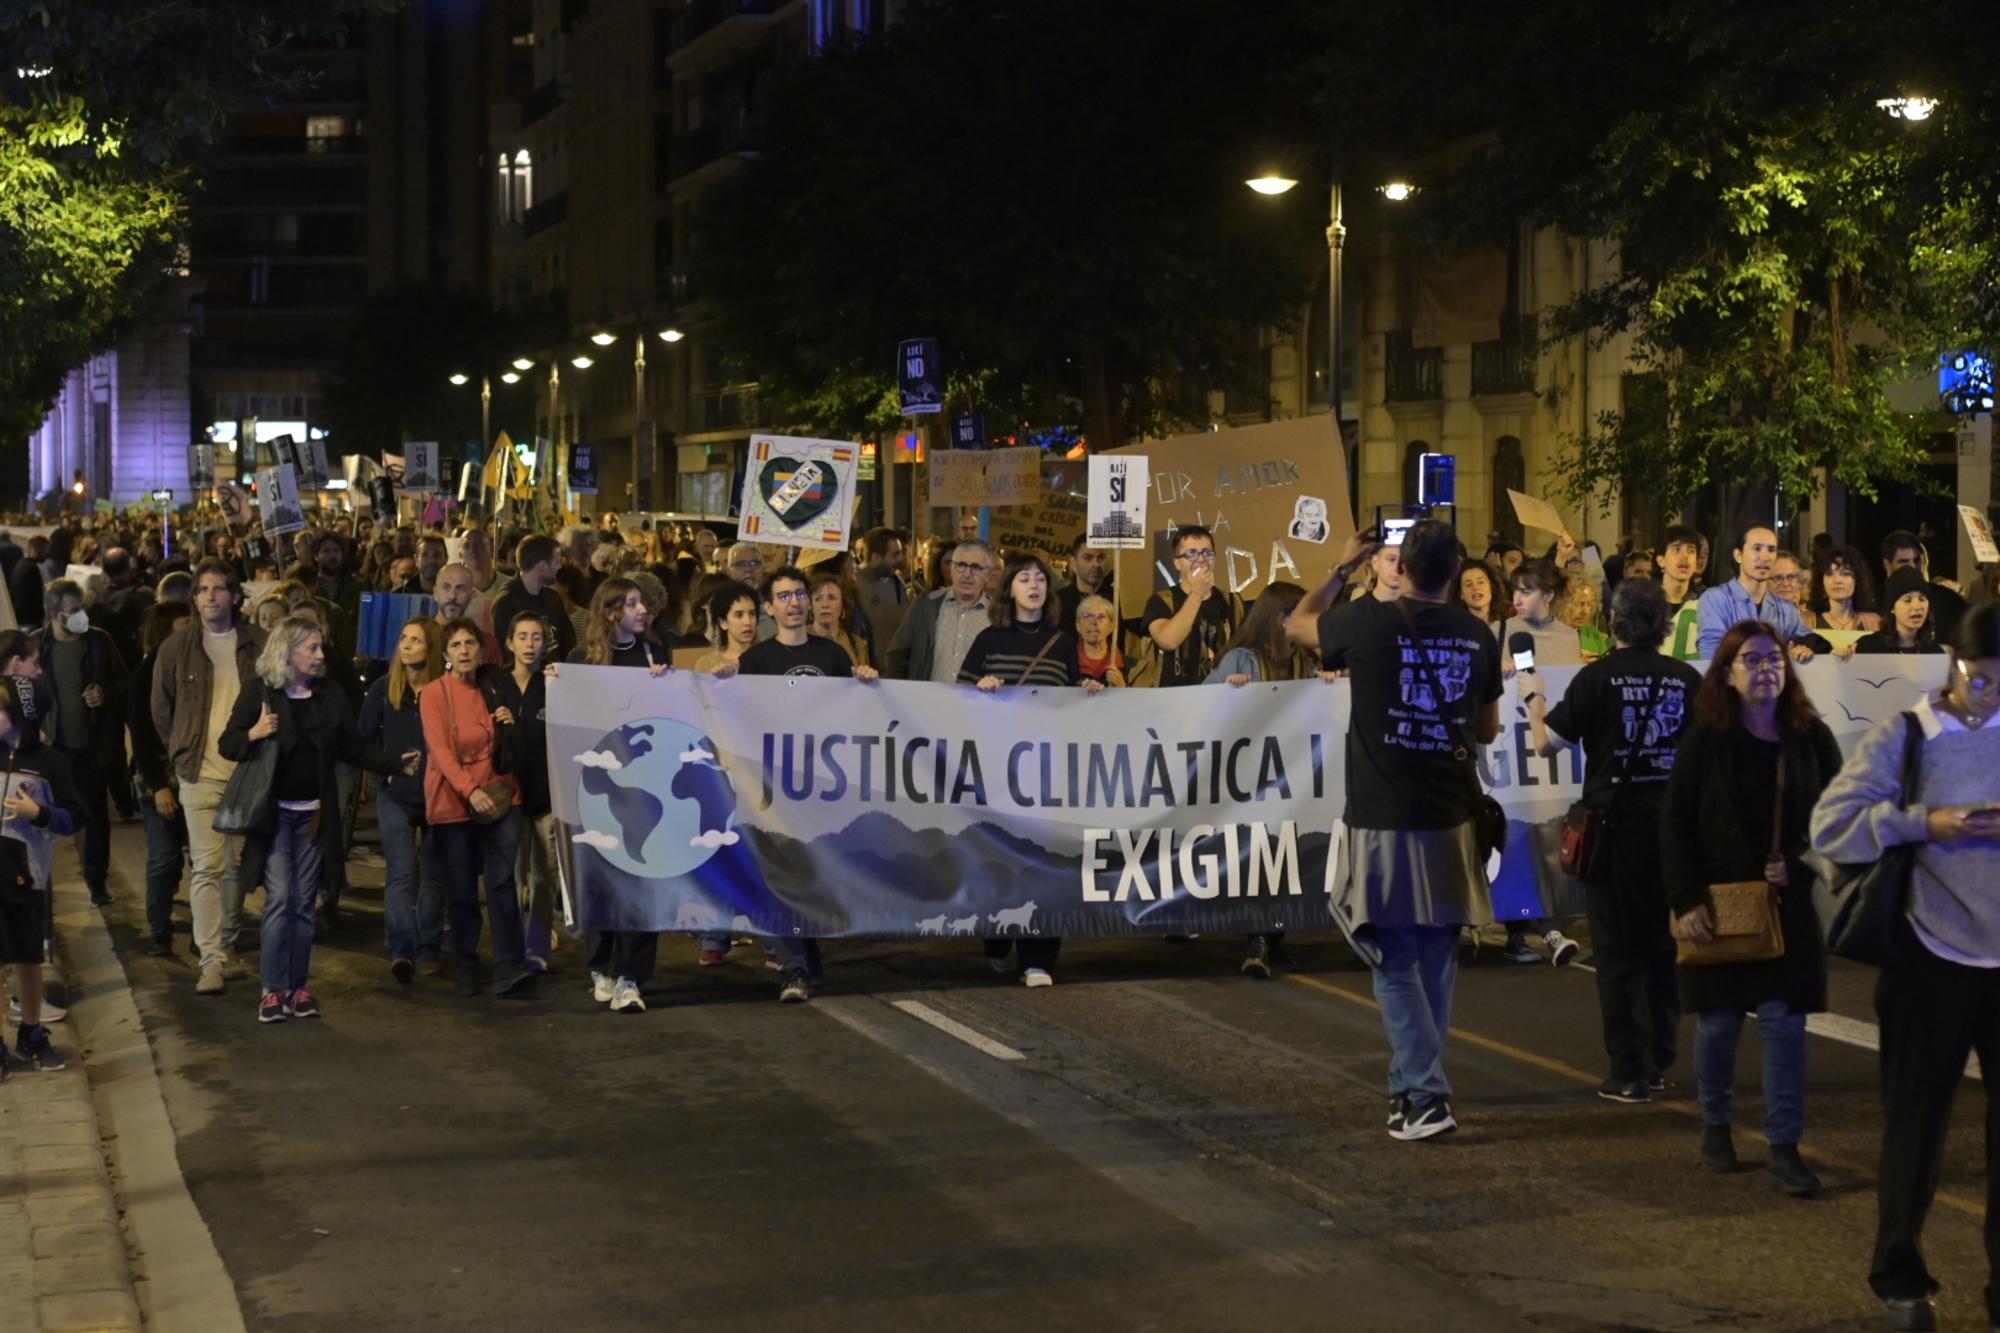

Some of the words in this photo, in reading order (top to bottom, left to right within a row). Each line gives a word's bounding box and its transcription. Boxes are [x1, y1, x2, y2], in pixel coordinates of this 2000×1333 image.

[906, 357, 924, 379] NO
[959, 426, 974, 441] NO
[574, 456, 590, 471] NO
[1214, 458, 1299, 498] AMOR
[1110, 473, 1125, 503] SÍ
[1397, 636, 1411, 645] La
[1436, 639, 1452, 647] del
[1455, 639, 1480, 650] Poble
[1611, 677, 1623, 685] La
[1625, 675, 1643, 684] Veu
[1384, 734, 1397, 744] La
[1419, 741, 1434, 750] del
[760, 720, 988, 811] JUSTÍCIA
[1007, 728, 1291, 808] CLIMÀTICA
[1311, 733, 1324, 798] I
[1082, 820, 1302, 902] EXIGIM
